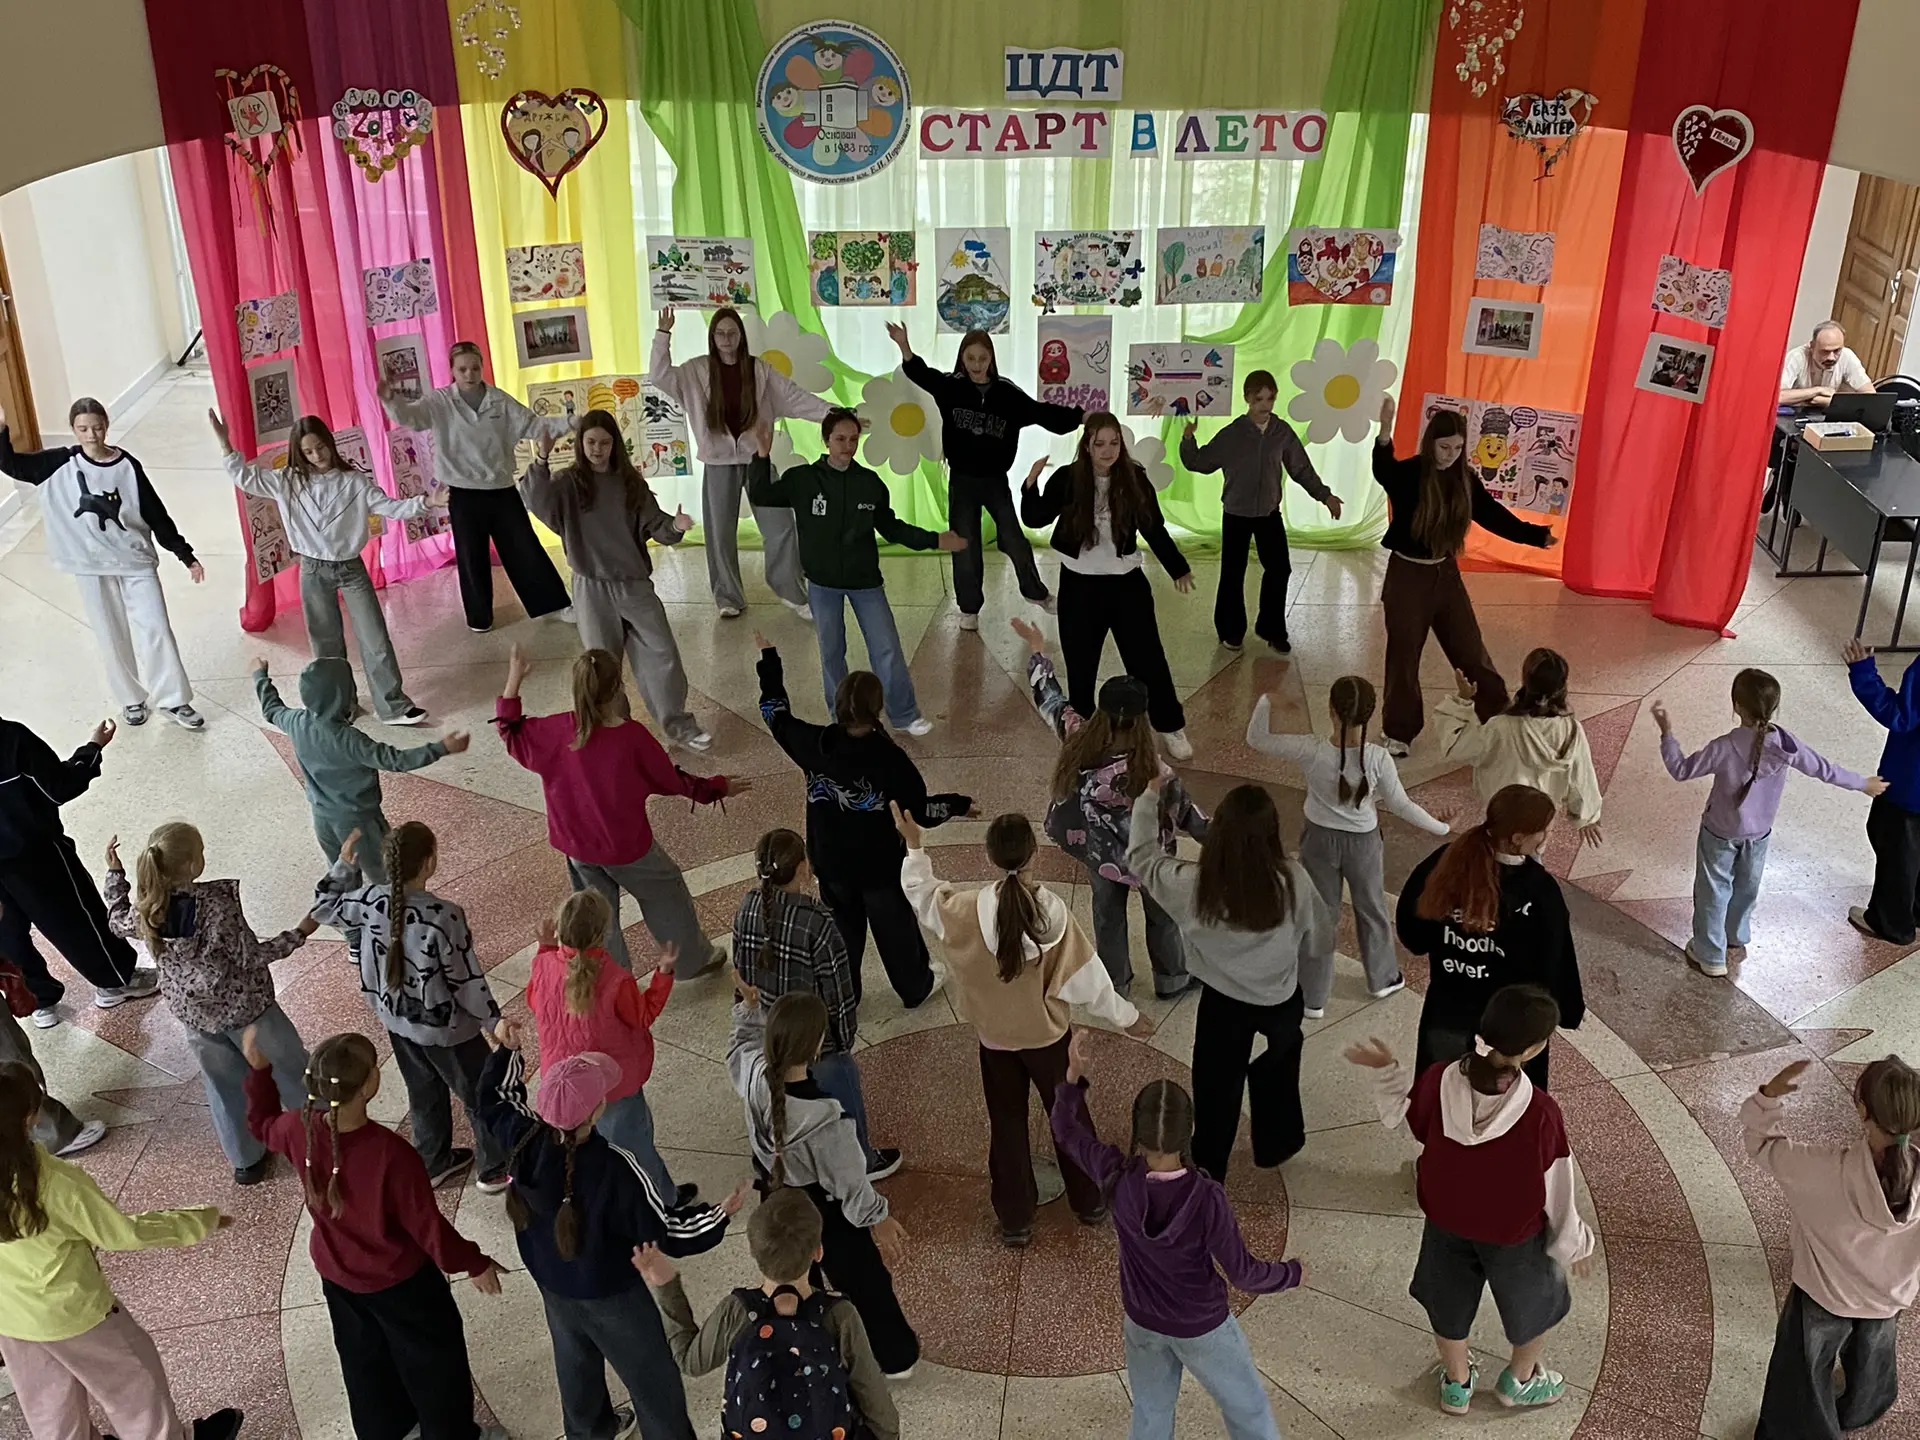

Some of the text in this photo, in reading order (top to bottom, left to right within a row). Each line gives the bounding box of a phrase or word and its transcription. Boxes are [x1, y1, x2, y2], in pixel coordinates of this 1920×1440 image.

[1006, 53, 1119, 99] ЦДТ
[817, 128, 857, 141] Основан
[920, 111, 1328, 153] СТАРТ В ЛЕТО
[824, 145, 831, 153] в
[858, 144, 879, 156] году
[1442, 958, 1489, 979] ever.
